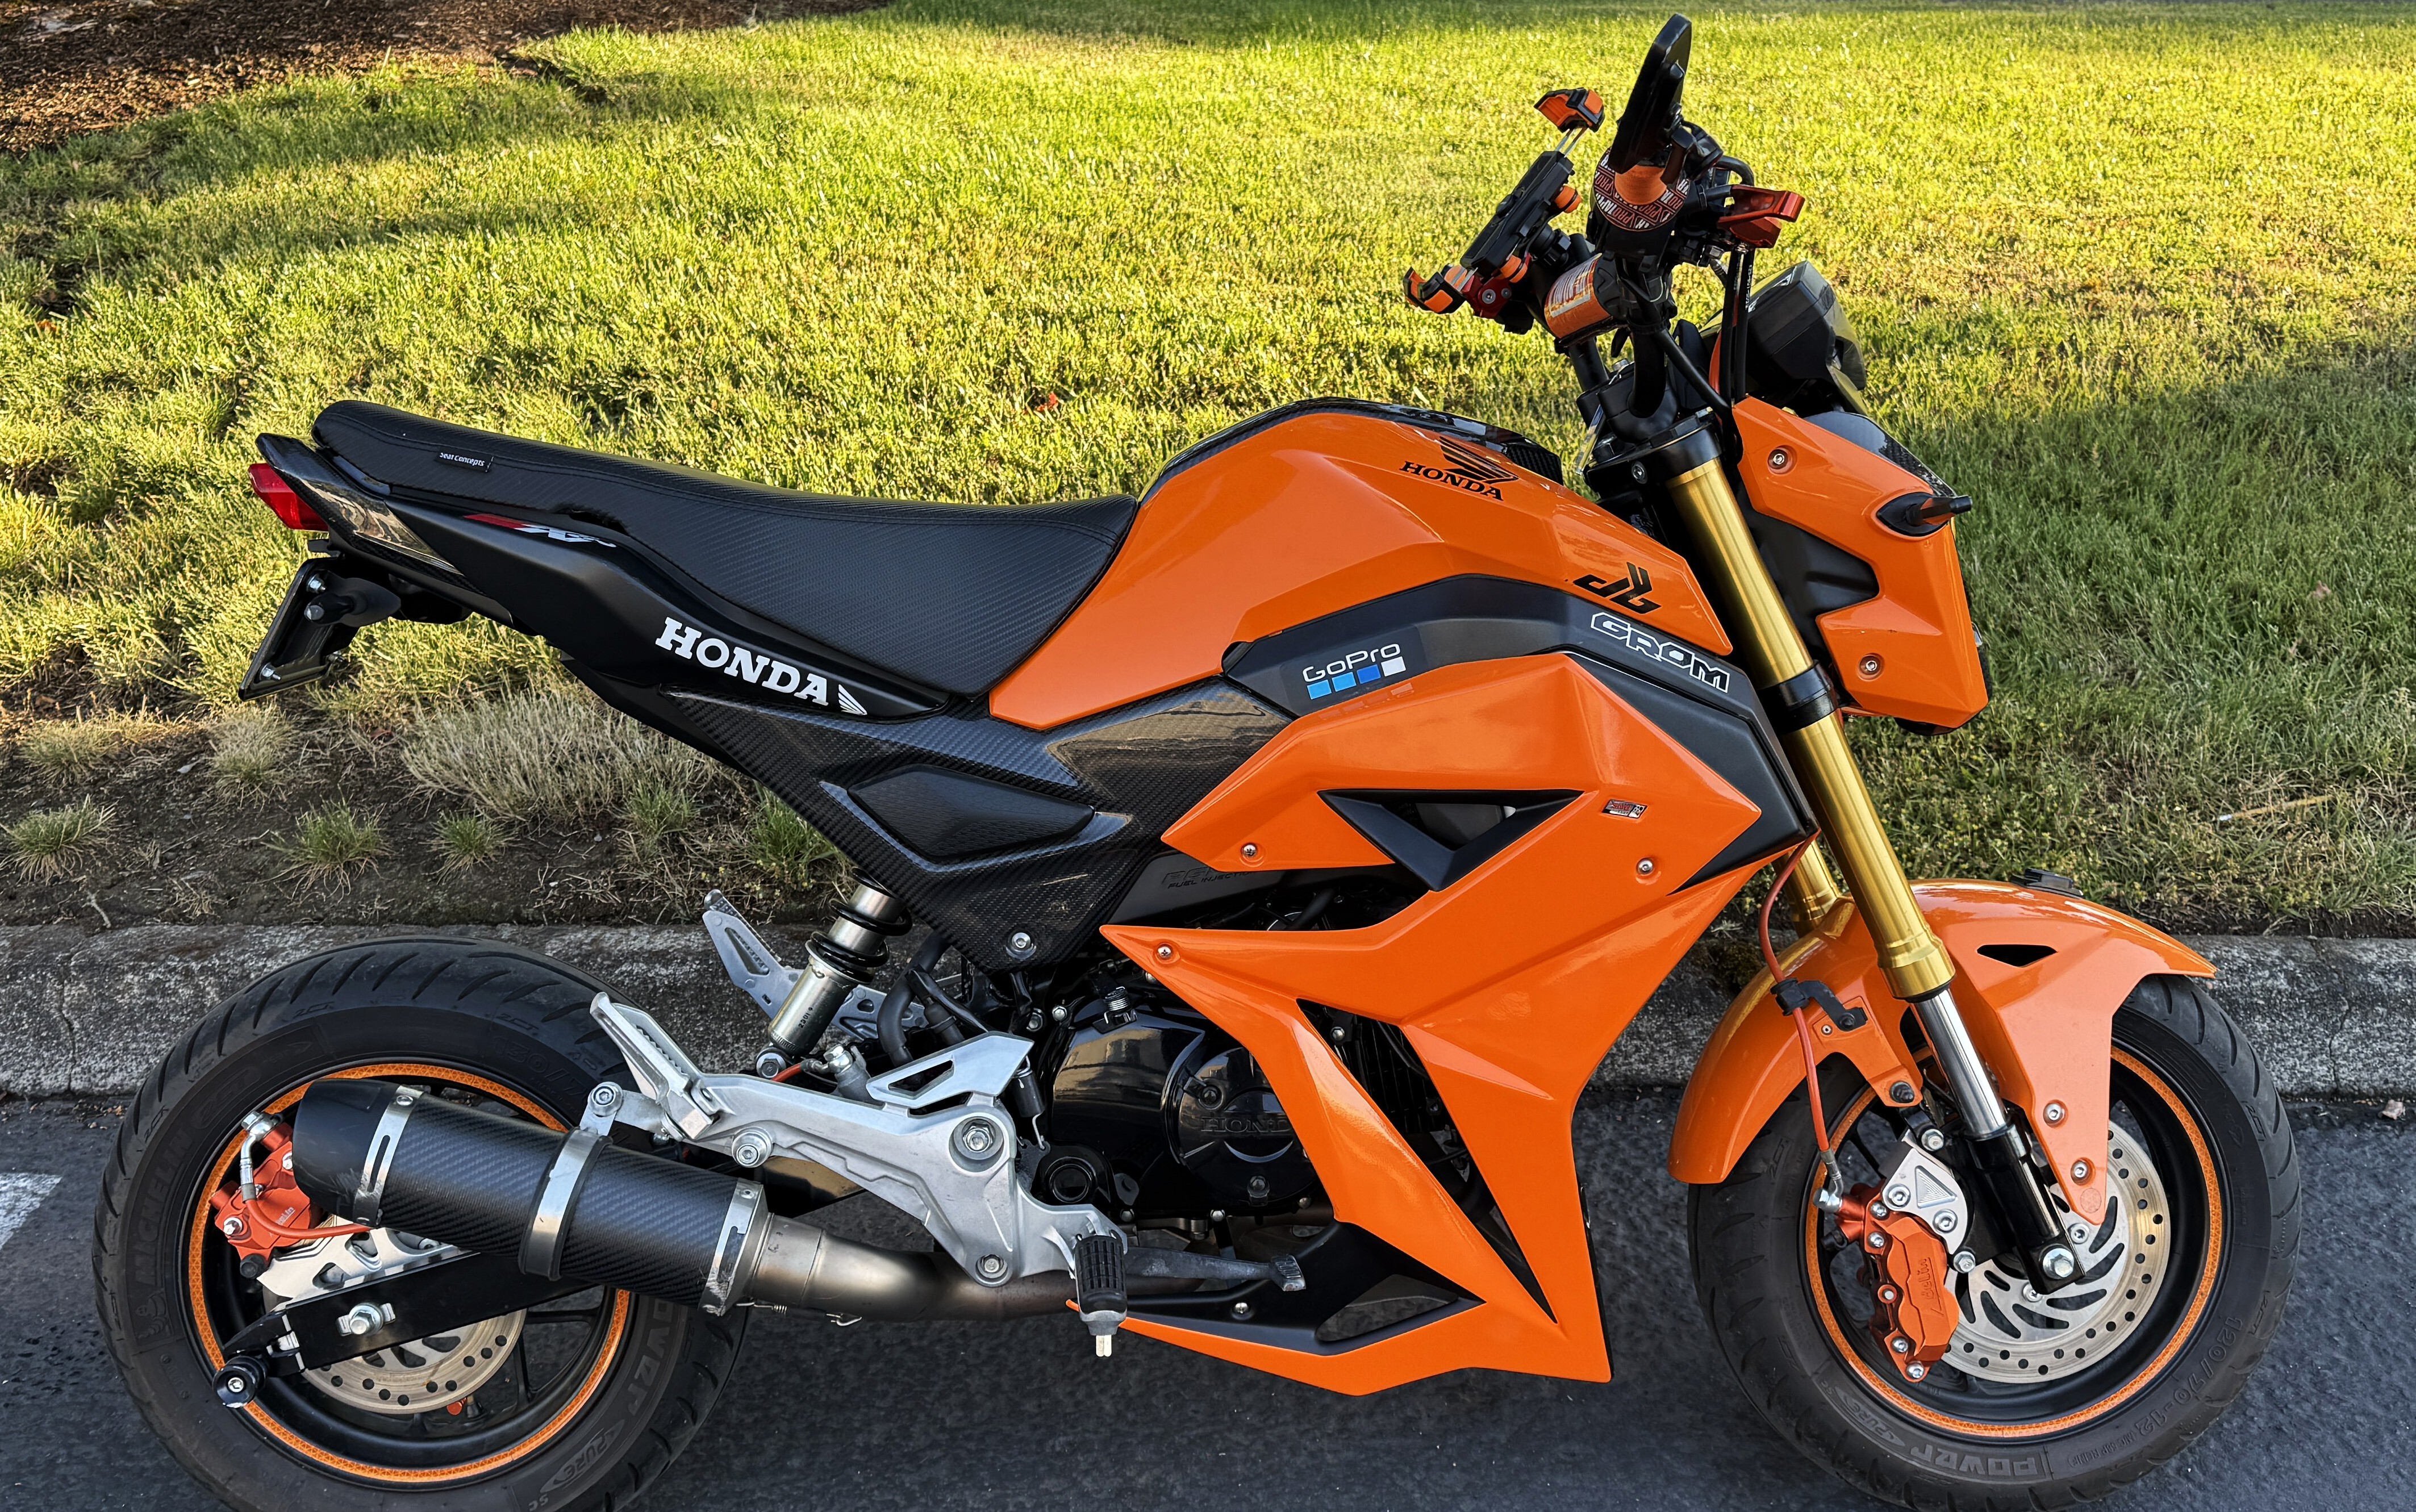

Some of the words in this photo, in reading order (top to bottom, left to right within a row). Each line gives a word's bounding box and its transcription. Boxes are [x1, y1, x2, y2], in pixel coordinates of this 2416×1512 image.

[454, 455, 485, 466] Concepts
[1399, 461, 1504, 502] HONDA
[655, 616, 829, 707] HONDA
[1302, 644, 1401, 682] GoPro
[1591, 612, 1730, 694] GROM
[1167, 880, 1197, 889] FUEL
[493, 1034, 588, 1097] 130/7
[1201, 1116, 1294, 1133] HOND
[134, 1127, 193, 1285] MICHELIN
[627, 1299, 674, 1415] OWER
[2136, 1316, 2242, 1436] 120/70-12
